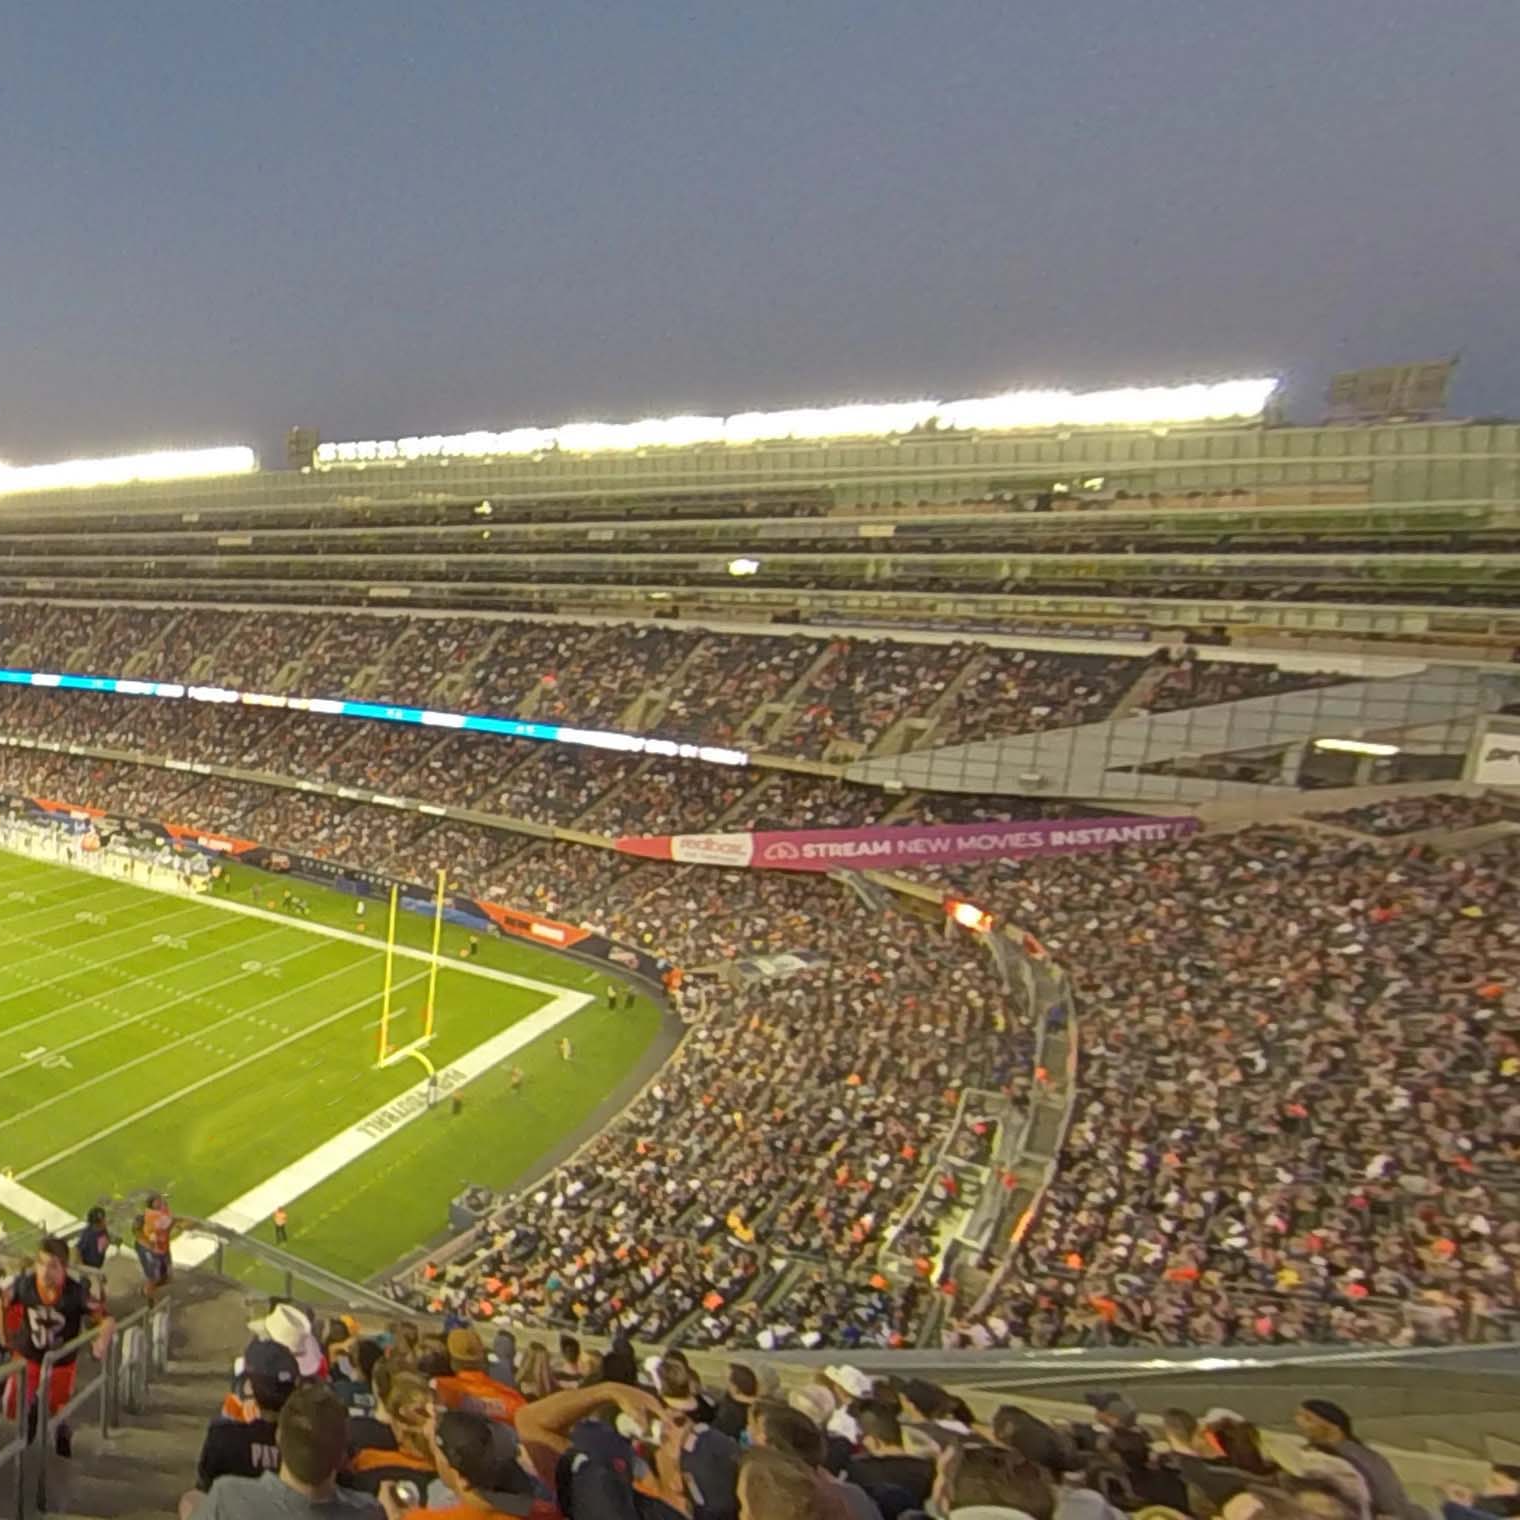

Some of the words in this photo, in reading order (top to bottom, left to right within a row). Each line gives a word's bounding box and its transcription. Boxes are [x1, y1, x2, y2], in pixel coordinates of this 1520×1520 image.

[802, 840, 891, 858] STREAM
[897, 837, 951, 855] NEW
[957, 831, 1044, 851] MOVIES
[250, 1442, 280, 1469] PAY
